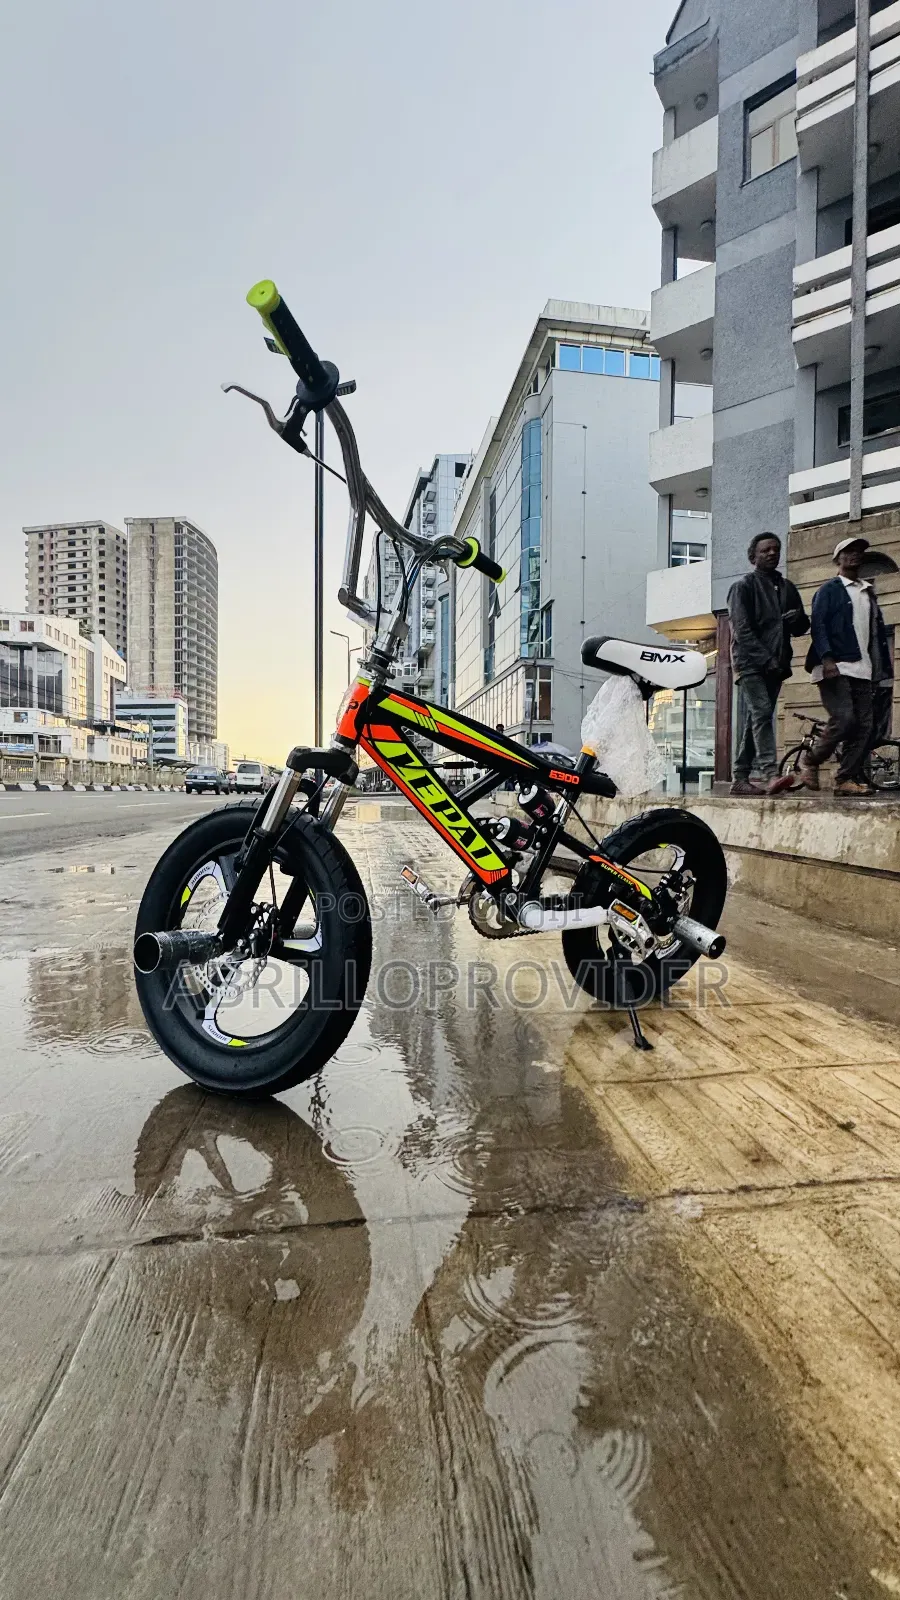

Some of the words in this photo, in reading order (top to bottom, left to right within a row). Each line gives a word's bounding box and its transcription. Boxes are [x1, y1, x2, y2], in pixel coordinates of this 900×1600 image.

[639, 650, 686, 663] BMX
[386, 751, 493, 860] LEPAI
[600, 862, 618, 876] SUPER
